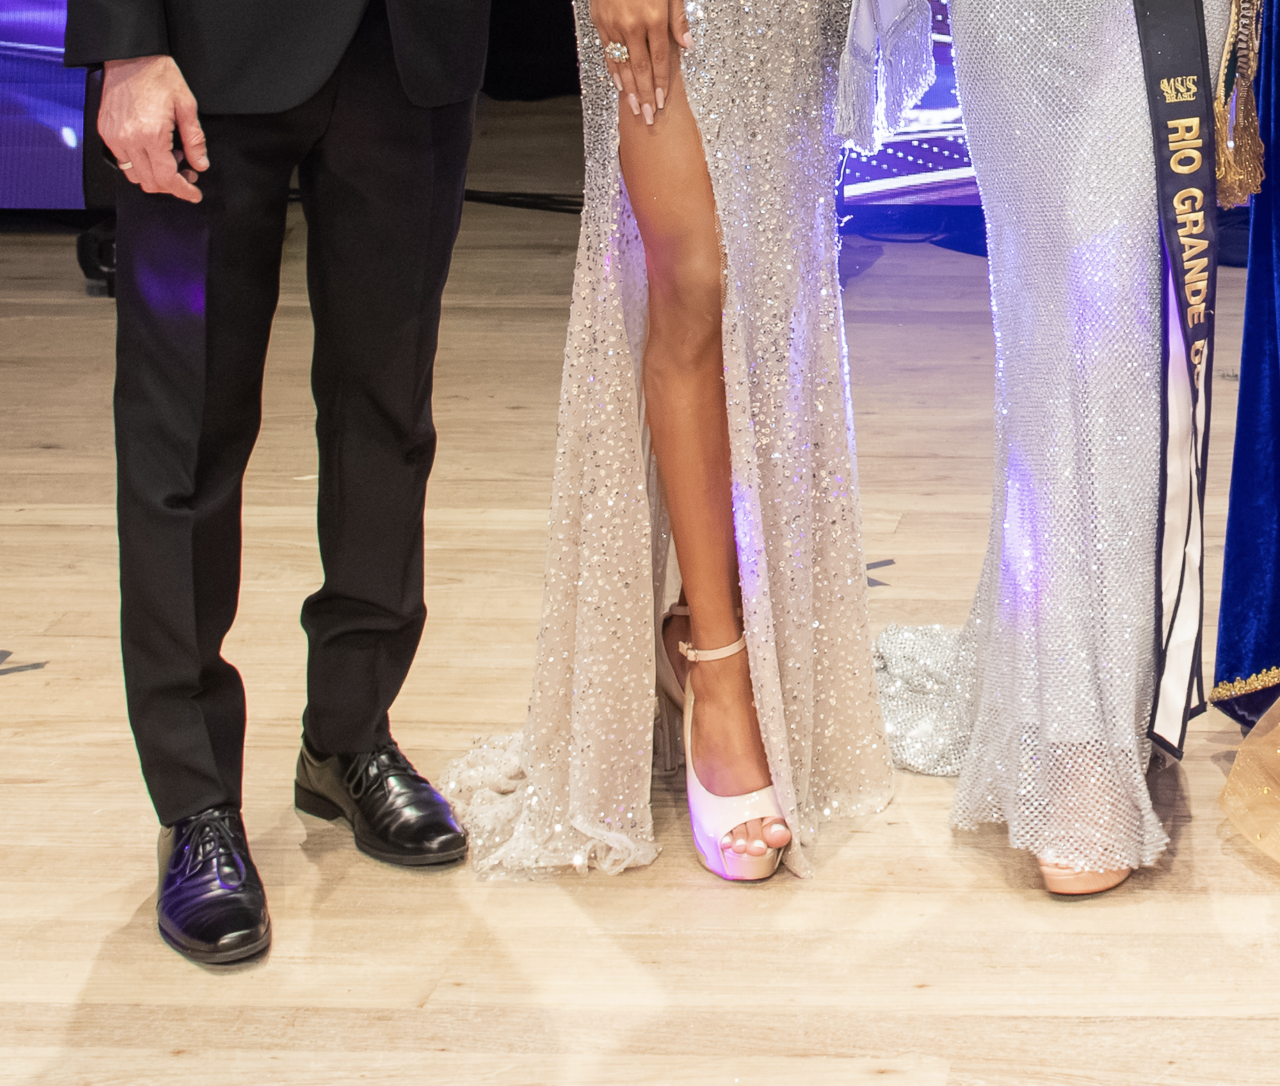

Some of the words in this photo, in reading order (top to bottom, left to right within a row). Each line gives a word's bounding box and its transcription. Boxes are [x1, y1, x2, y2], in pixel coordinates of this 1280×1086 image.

[1164, 92, 1197, 103] BRASIL
[1166, 116, 1203, 175] RIO
[1172, 187, 1209, 329] GRANDE
